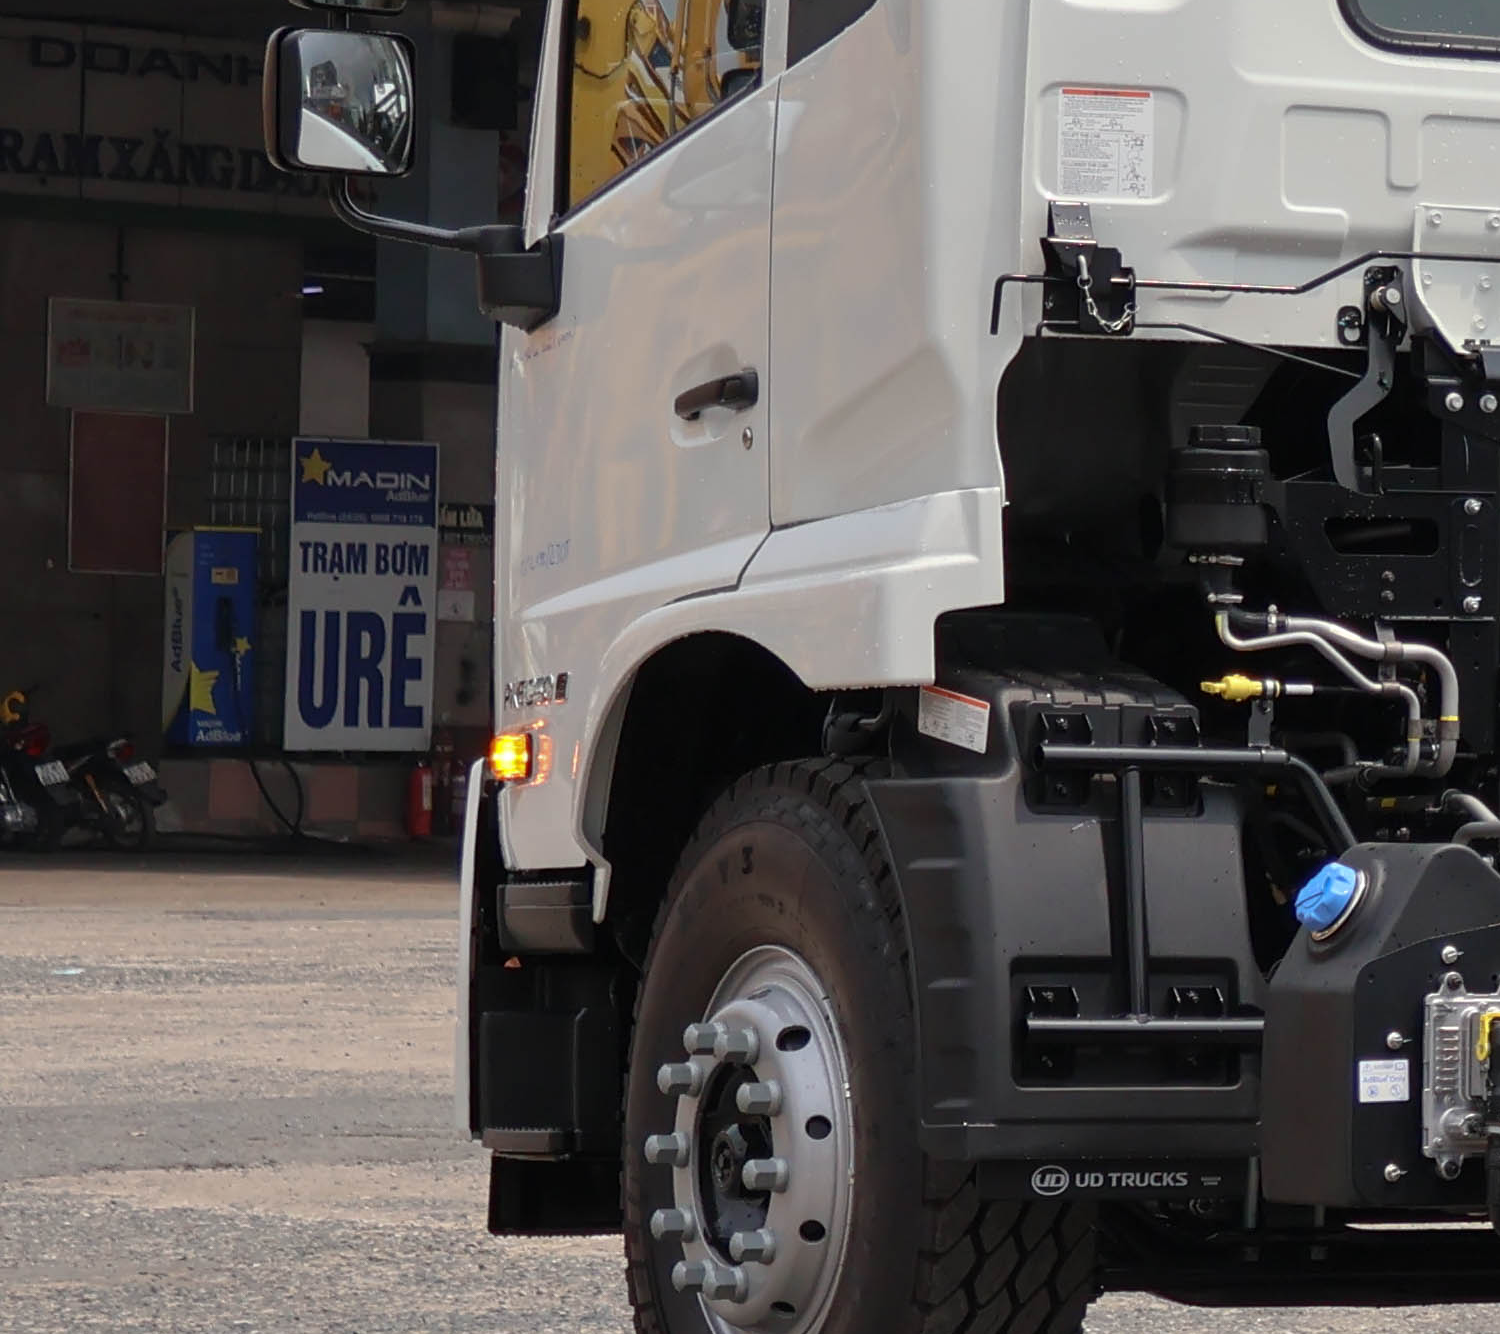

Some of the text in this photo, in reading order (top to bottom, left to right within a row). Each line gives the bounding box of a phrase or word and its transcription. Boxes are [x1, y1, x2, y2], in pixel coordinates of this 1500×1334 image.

[326, 470, 430, 490] MADIN
[300, 541, 367, 581] TRẠM
[376, 540, 429, 576] BƠM
[298, 586, 427, 730] URÊ
[1075, 1172, 1104, 1188] UD
[1108, 1171, 1189, 1188] TRUCKS
